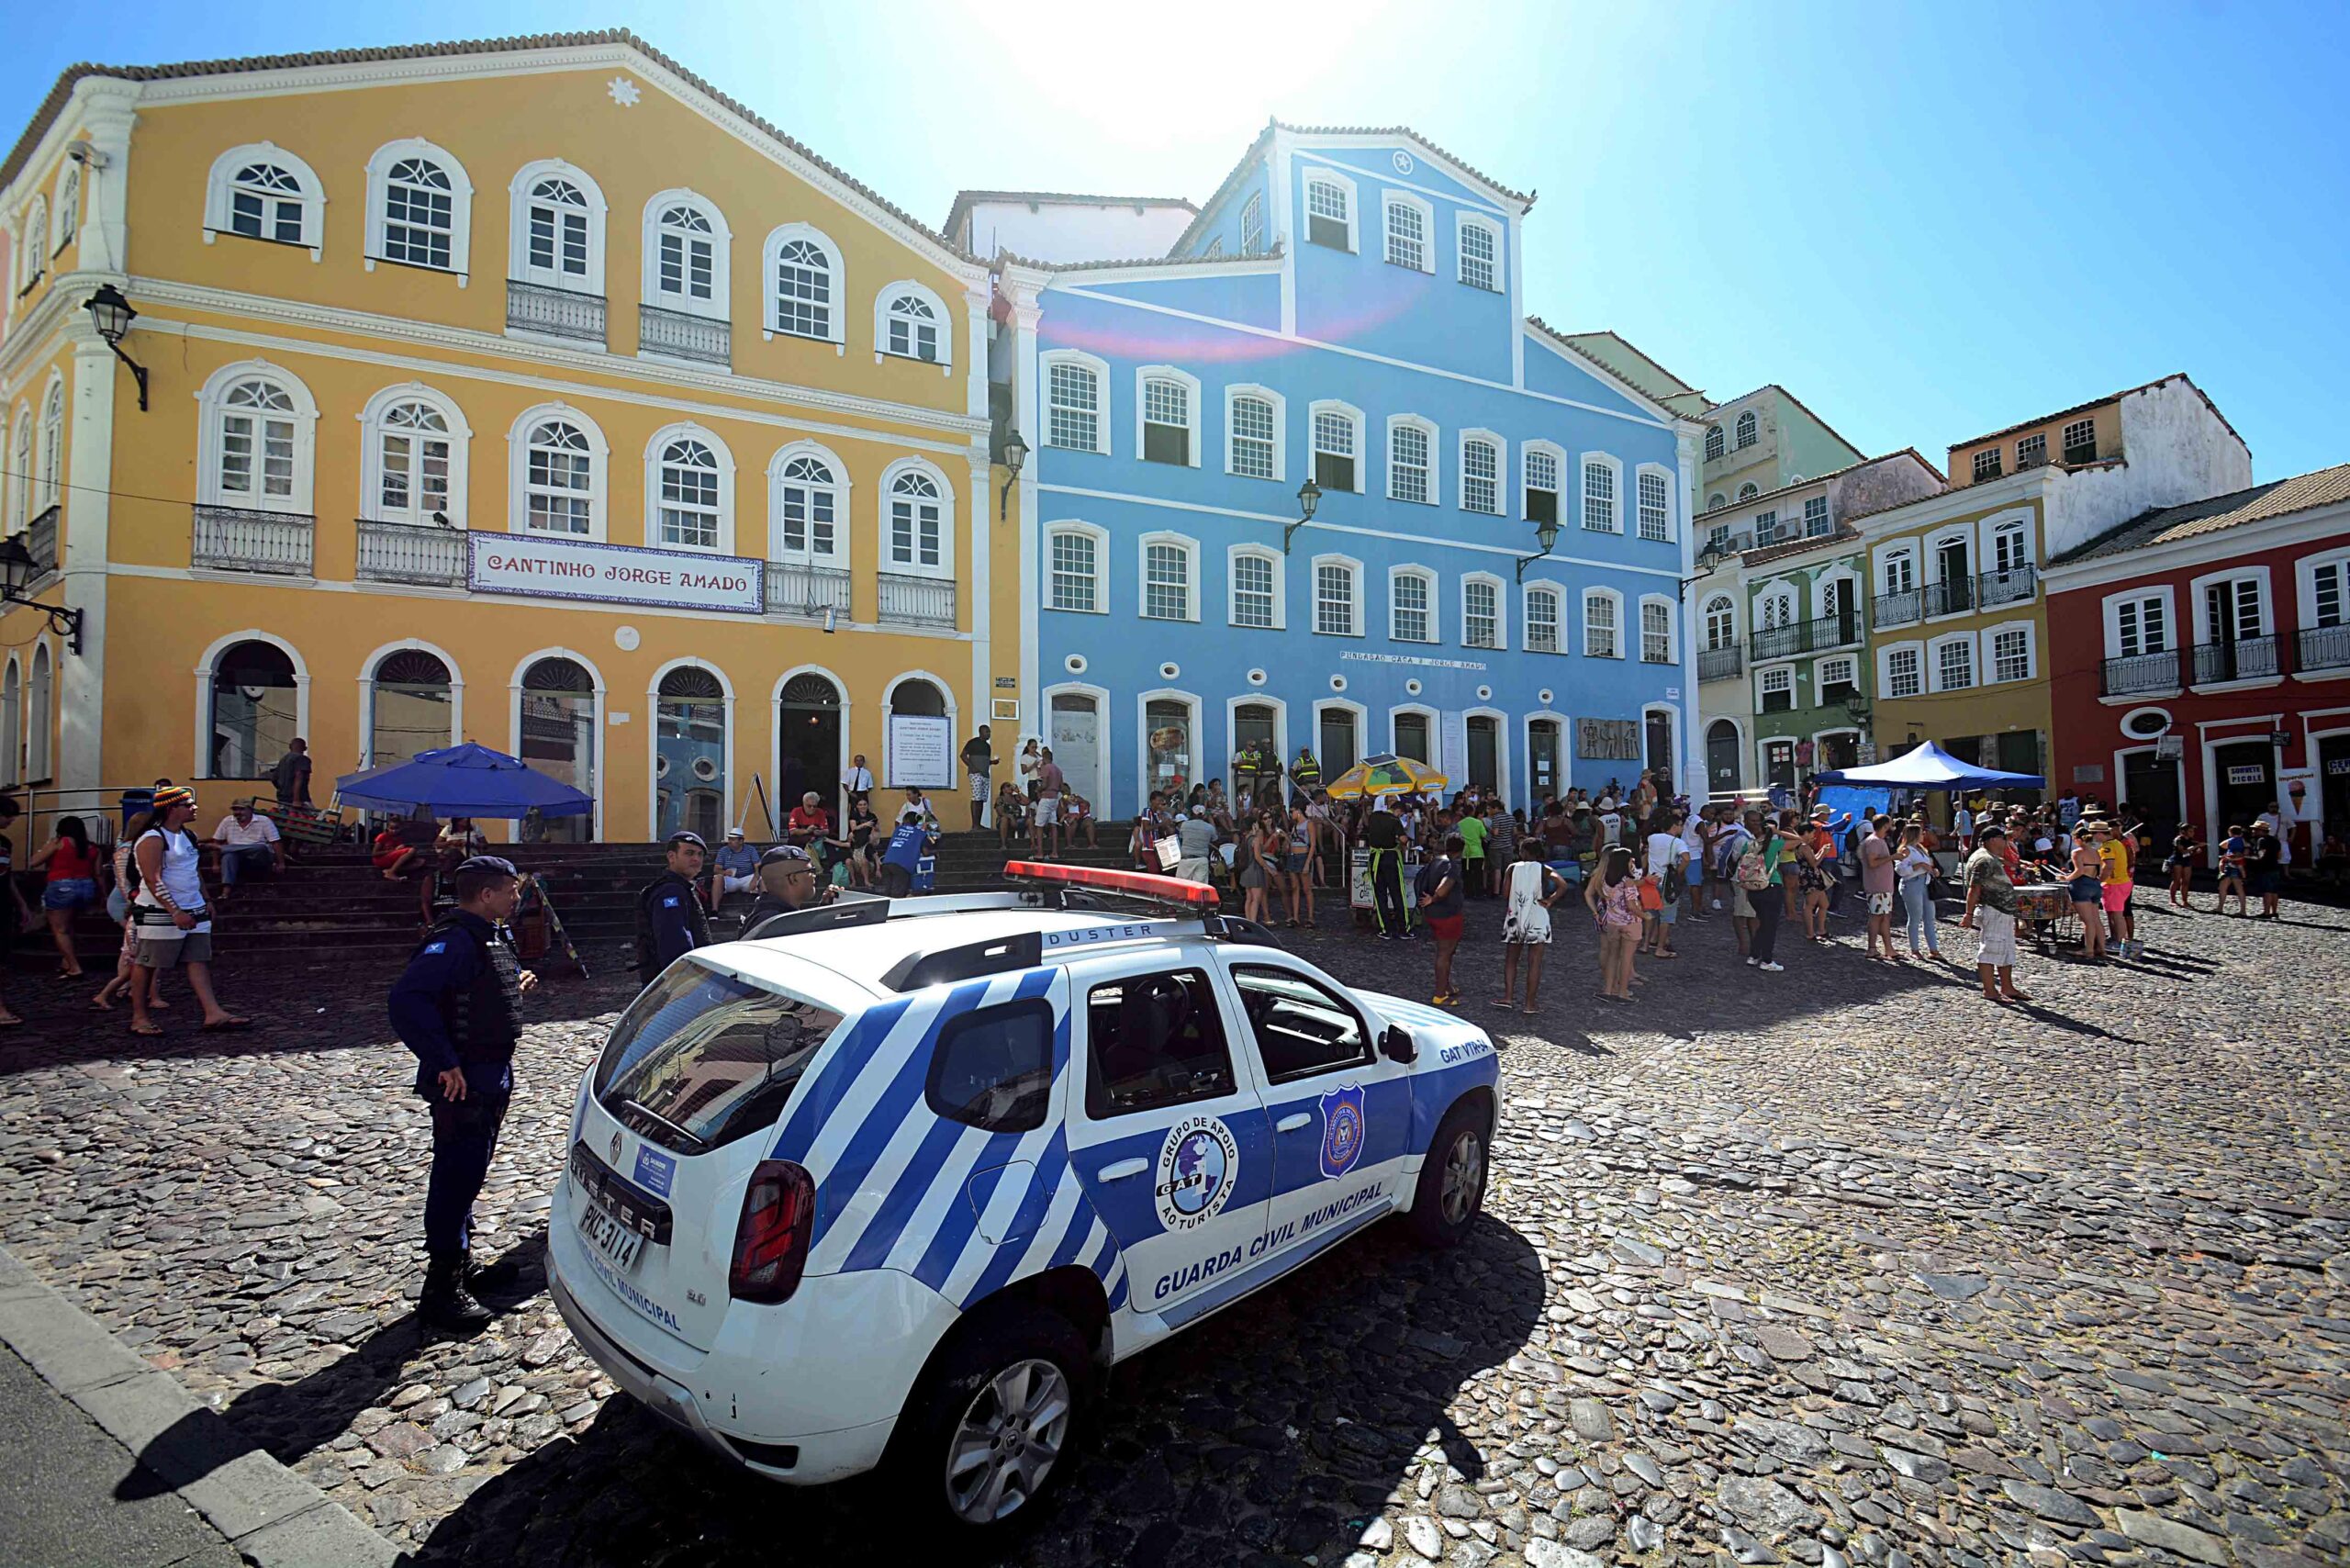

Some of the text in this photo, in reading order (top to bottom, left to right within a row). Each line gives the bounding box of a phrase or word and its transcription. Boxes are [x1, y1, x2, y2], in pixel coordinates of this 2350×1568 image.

[487, 555, 747, 592] CANTINHO JORGE AMADO
[1048, 924, 1151, 945] DUSTER
[1439, 1046, 1462, 1064] GAT
[1162, 1116, 1236, 1168] GRUPO DE APOIO
[1160, 1175, 1199, 1194] GAT
[1162, 1180, 1235, 1230] AO TURISTA
[1154, 1182, 1383, 1300] GUARDA CIVIL MUNICIPAL
[595, 1257, 681, 1332] CIVIL MUNICIPAL
